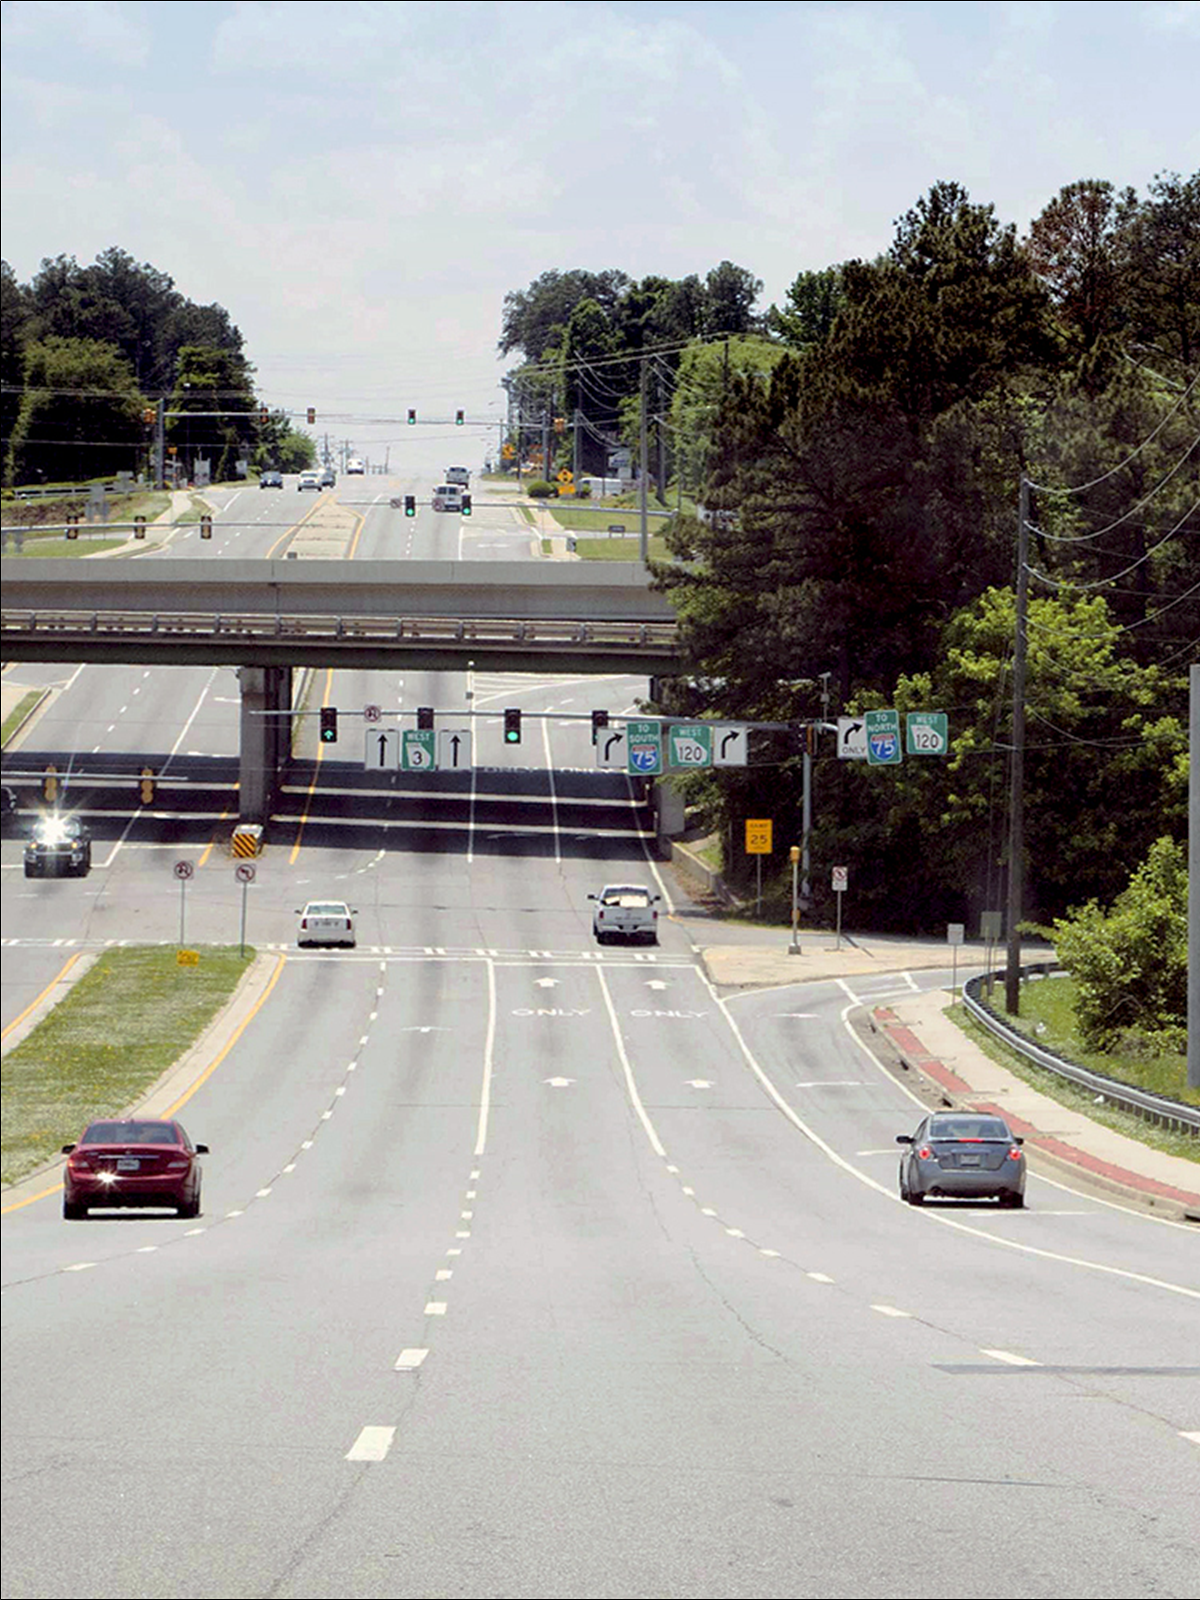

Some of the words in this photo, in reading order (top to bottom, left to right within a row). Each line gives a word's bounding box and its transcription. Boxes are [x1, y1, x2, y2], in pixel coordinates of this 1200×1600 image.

[875, 713, 888, 722] TO
[637, 724, 650, 733] TO
[867, 724, 897, 732] NORTH
[629, 734, 659, 743] SOUTH
[916, 733, 940, 749] 120
[679, 745, 703, 761] 120
[842, 746, 867, 755] ONLY
[876, 740, 896, 756] 75
[412, 750, 423, 766] 3
[635, 751, 657, 767] 75
[750, 833, 769, 845] 25
[511, 1008, 590, 1017] ONLY
[630, 1009, 709, 1019] ONLY
